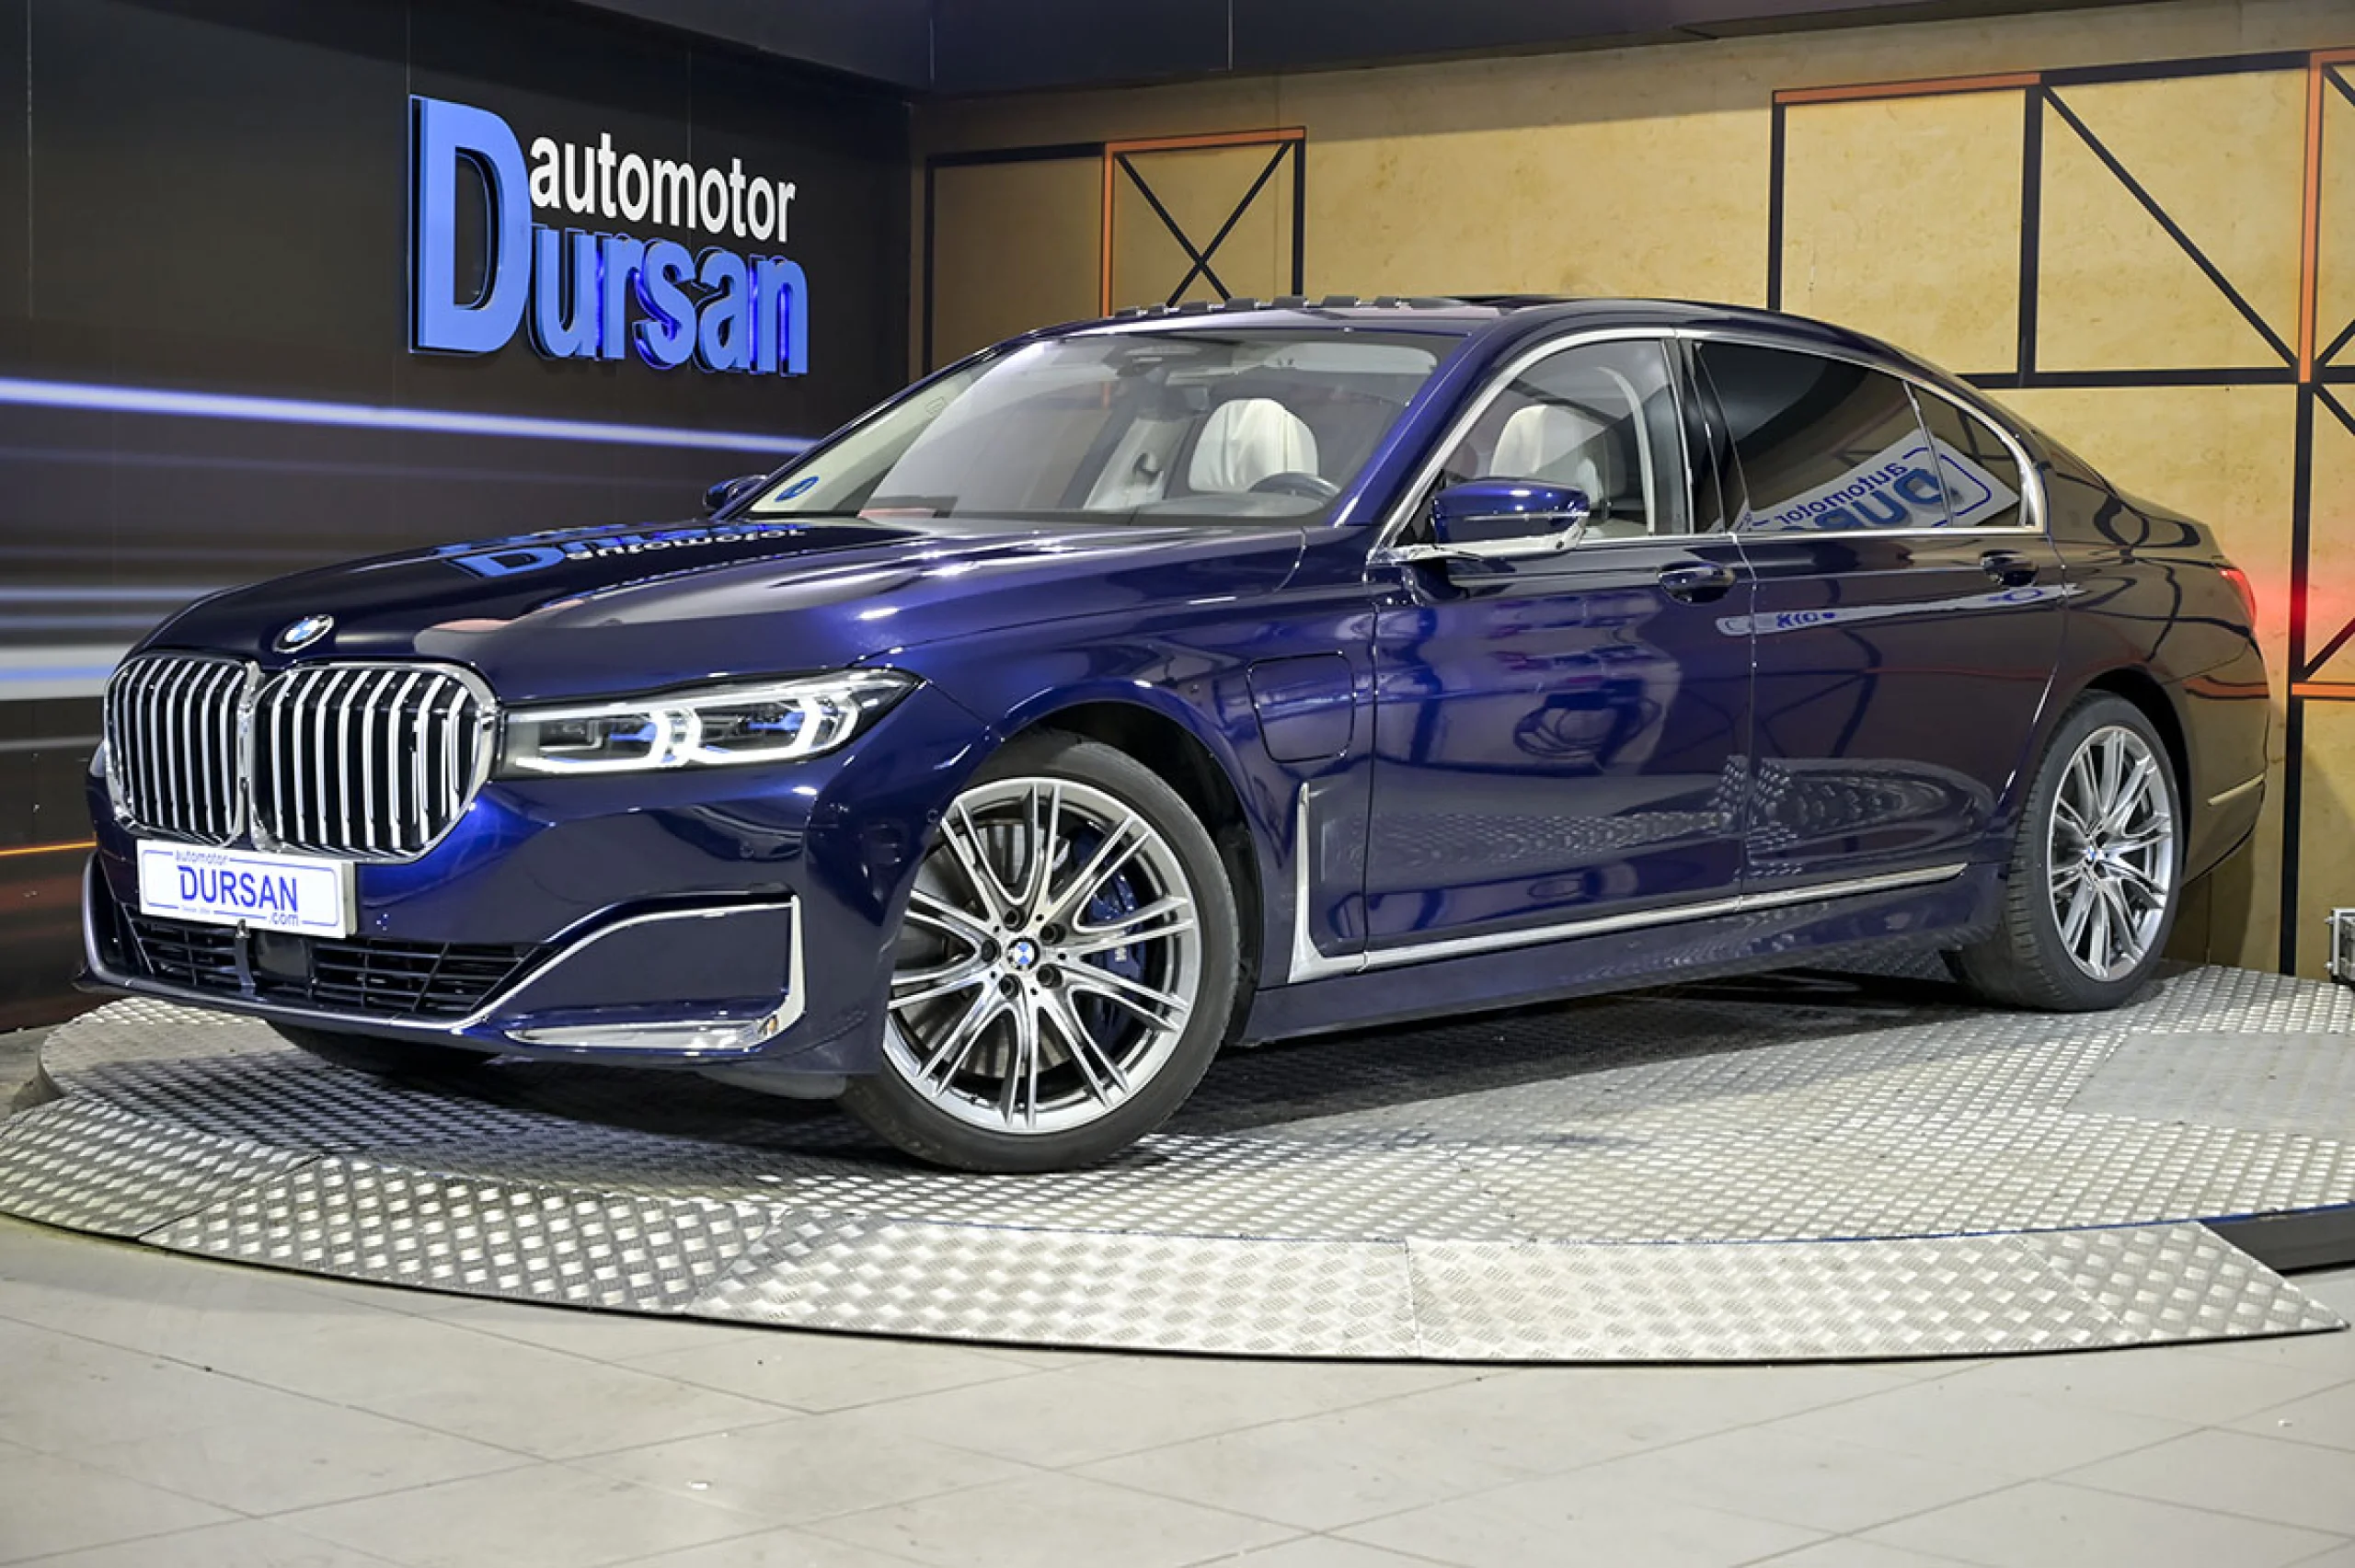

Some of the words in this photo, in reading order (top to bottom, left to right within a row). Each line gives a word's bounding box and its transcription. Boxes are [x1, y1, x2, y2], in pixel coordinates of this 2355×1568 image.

[409, 94, 809, 376] Dursan
[529, 132, 796, 242] automotor
[178, 865, 298, 912] DURSAN
